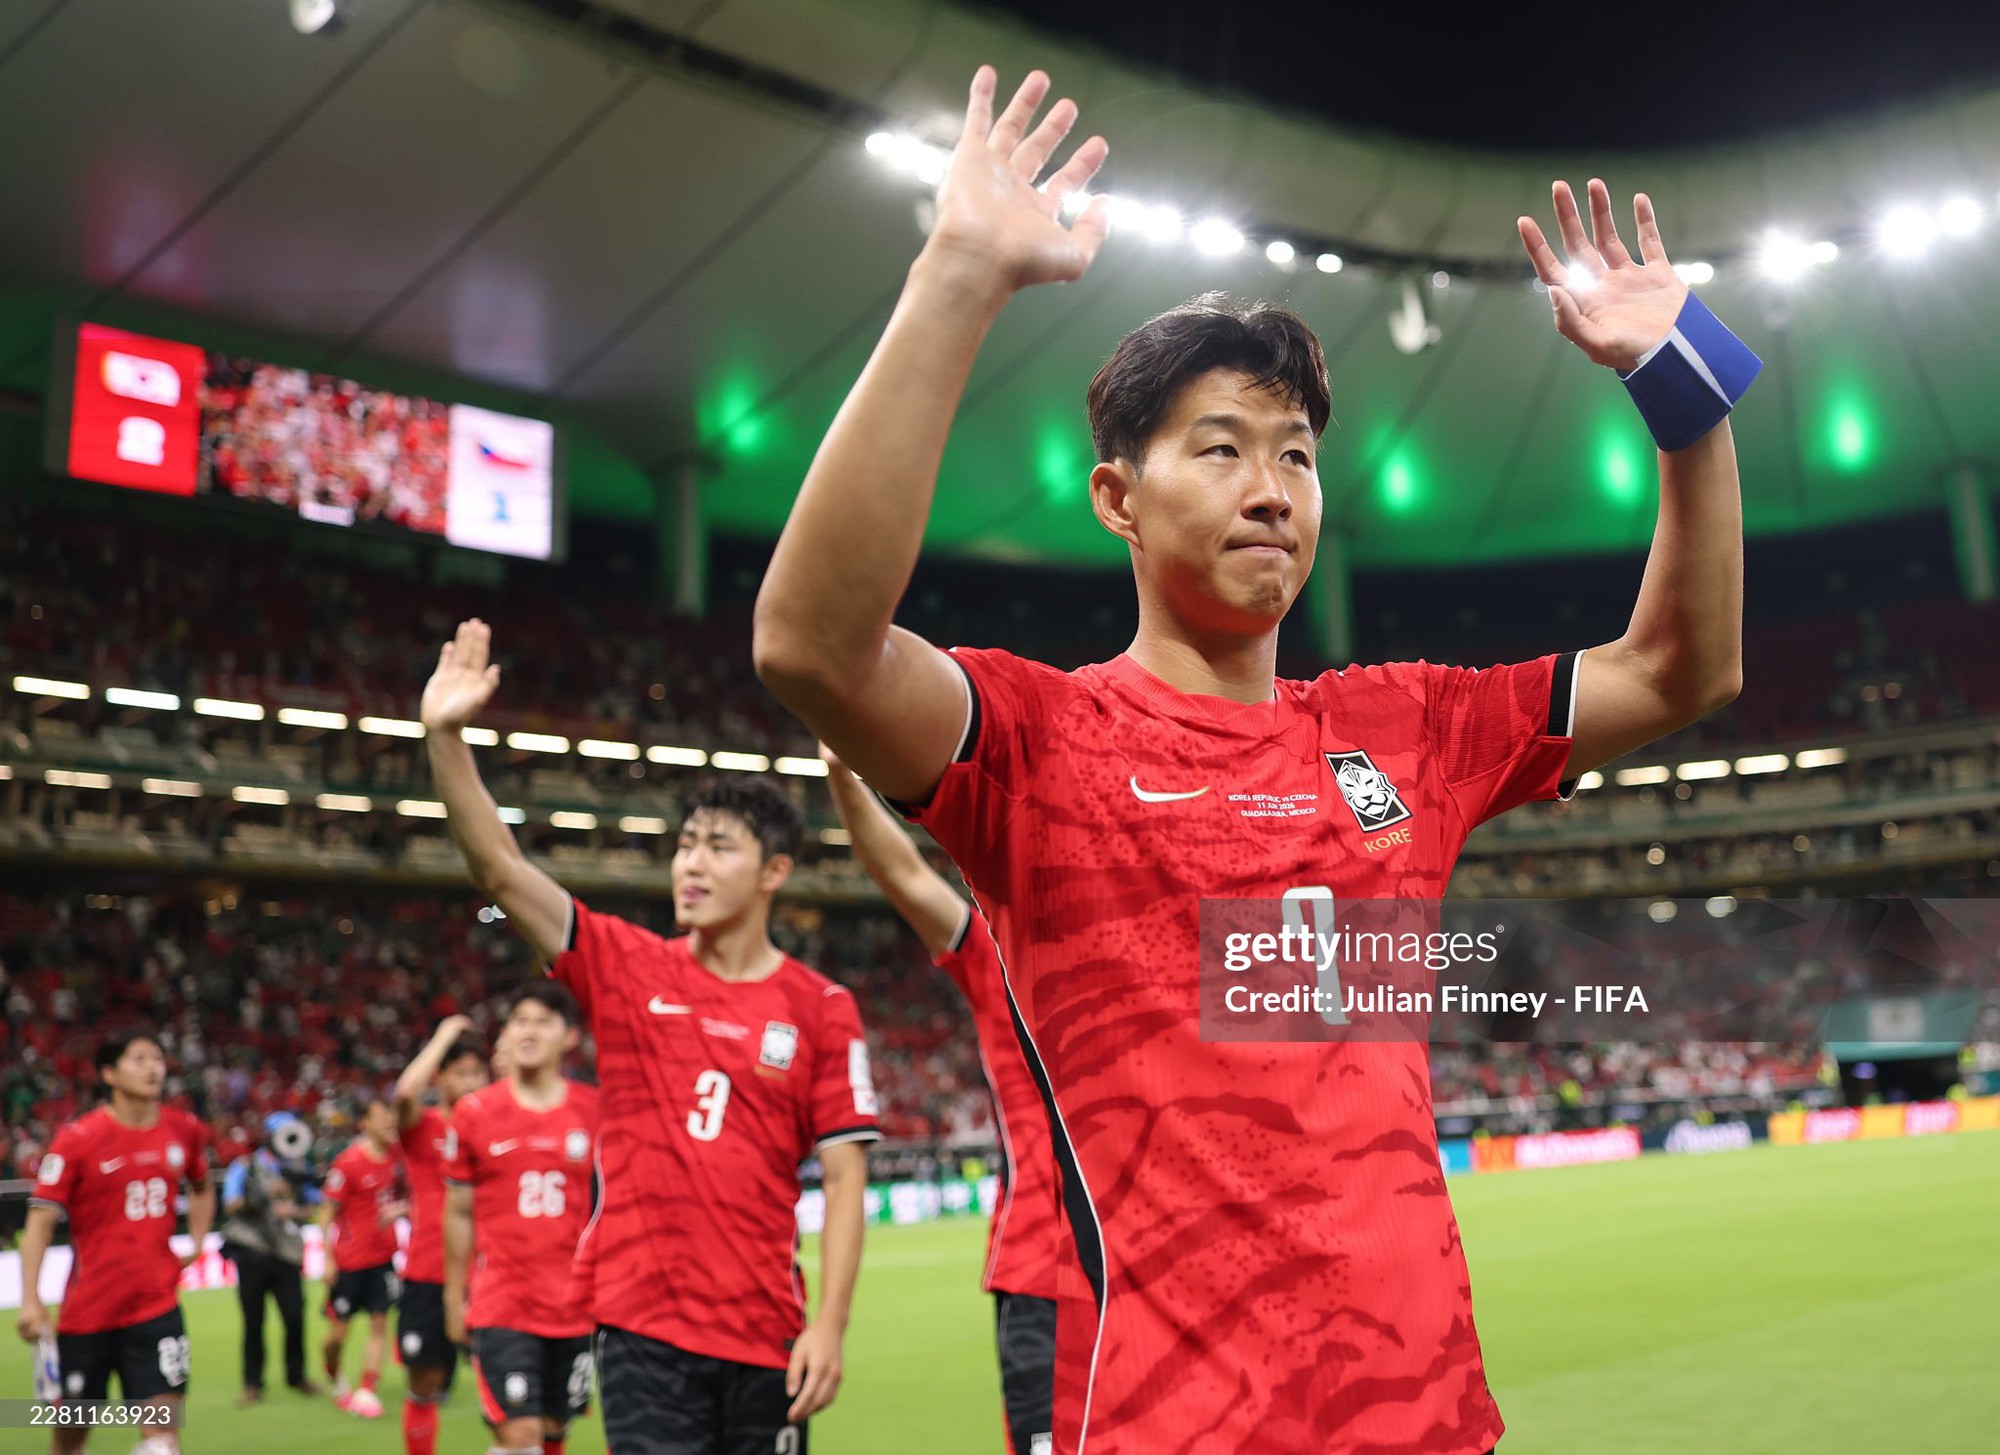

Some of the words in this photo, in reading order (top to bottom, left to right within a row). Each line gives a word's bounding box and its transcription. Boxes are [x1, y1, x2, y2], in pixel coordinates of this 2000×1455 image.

[686, 1069, 731, 1142] 3
[123, 1176, 169, 1222] 22
[517, 1170, 567, 1218] 26
